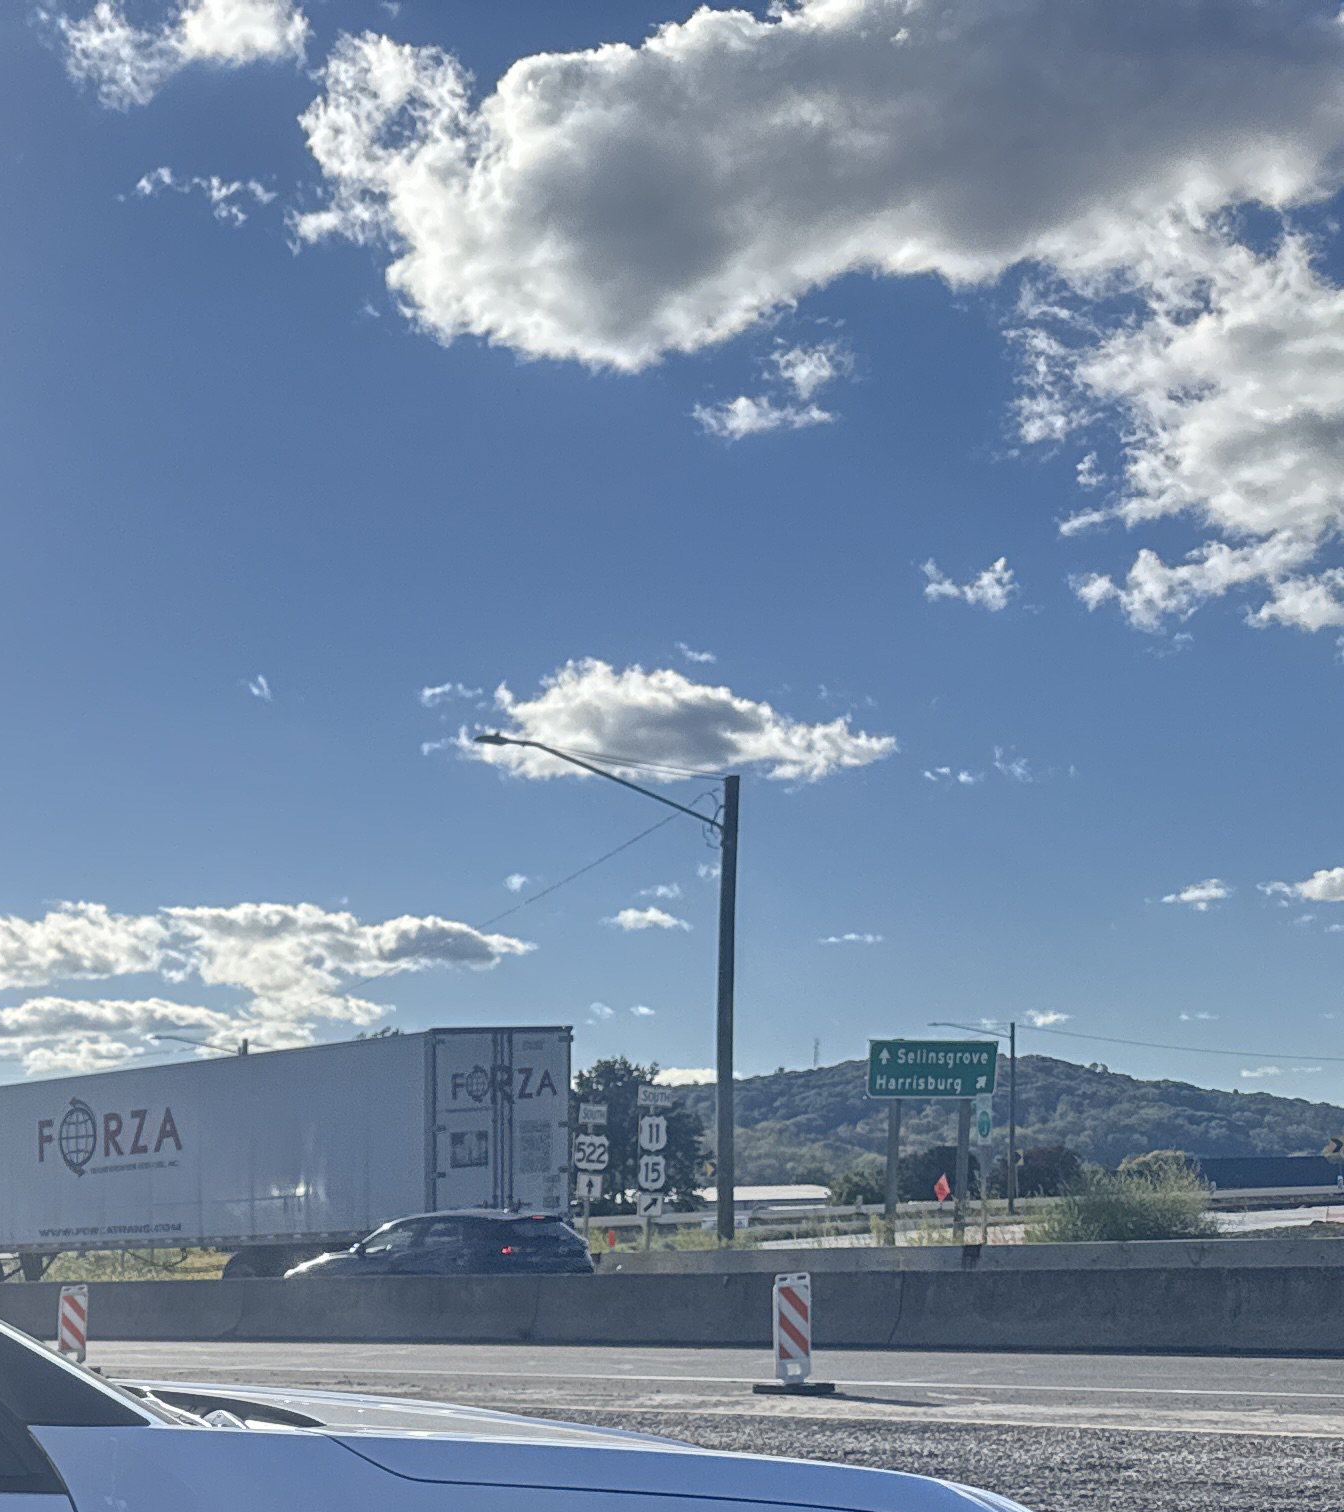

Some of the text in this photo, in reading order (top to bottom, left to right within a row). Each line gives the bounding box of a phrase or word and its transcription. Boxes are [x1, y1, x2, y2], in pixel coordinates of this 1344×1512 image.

[897, 1048, 989, 1069] Selinsgrove
[451, 1066, 558, 1104] FORZA
[875, 1075, 962, 1094] Harrisburg
[38, 1099, 183, 1174] FORZA
[648, 1123, 660, 1144] 11
[576, 1141, 606, 1164] 522
[645, 1162, 661, 1183] 15
